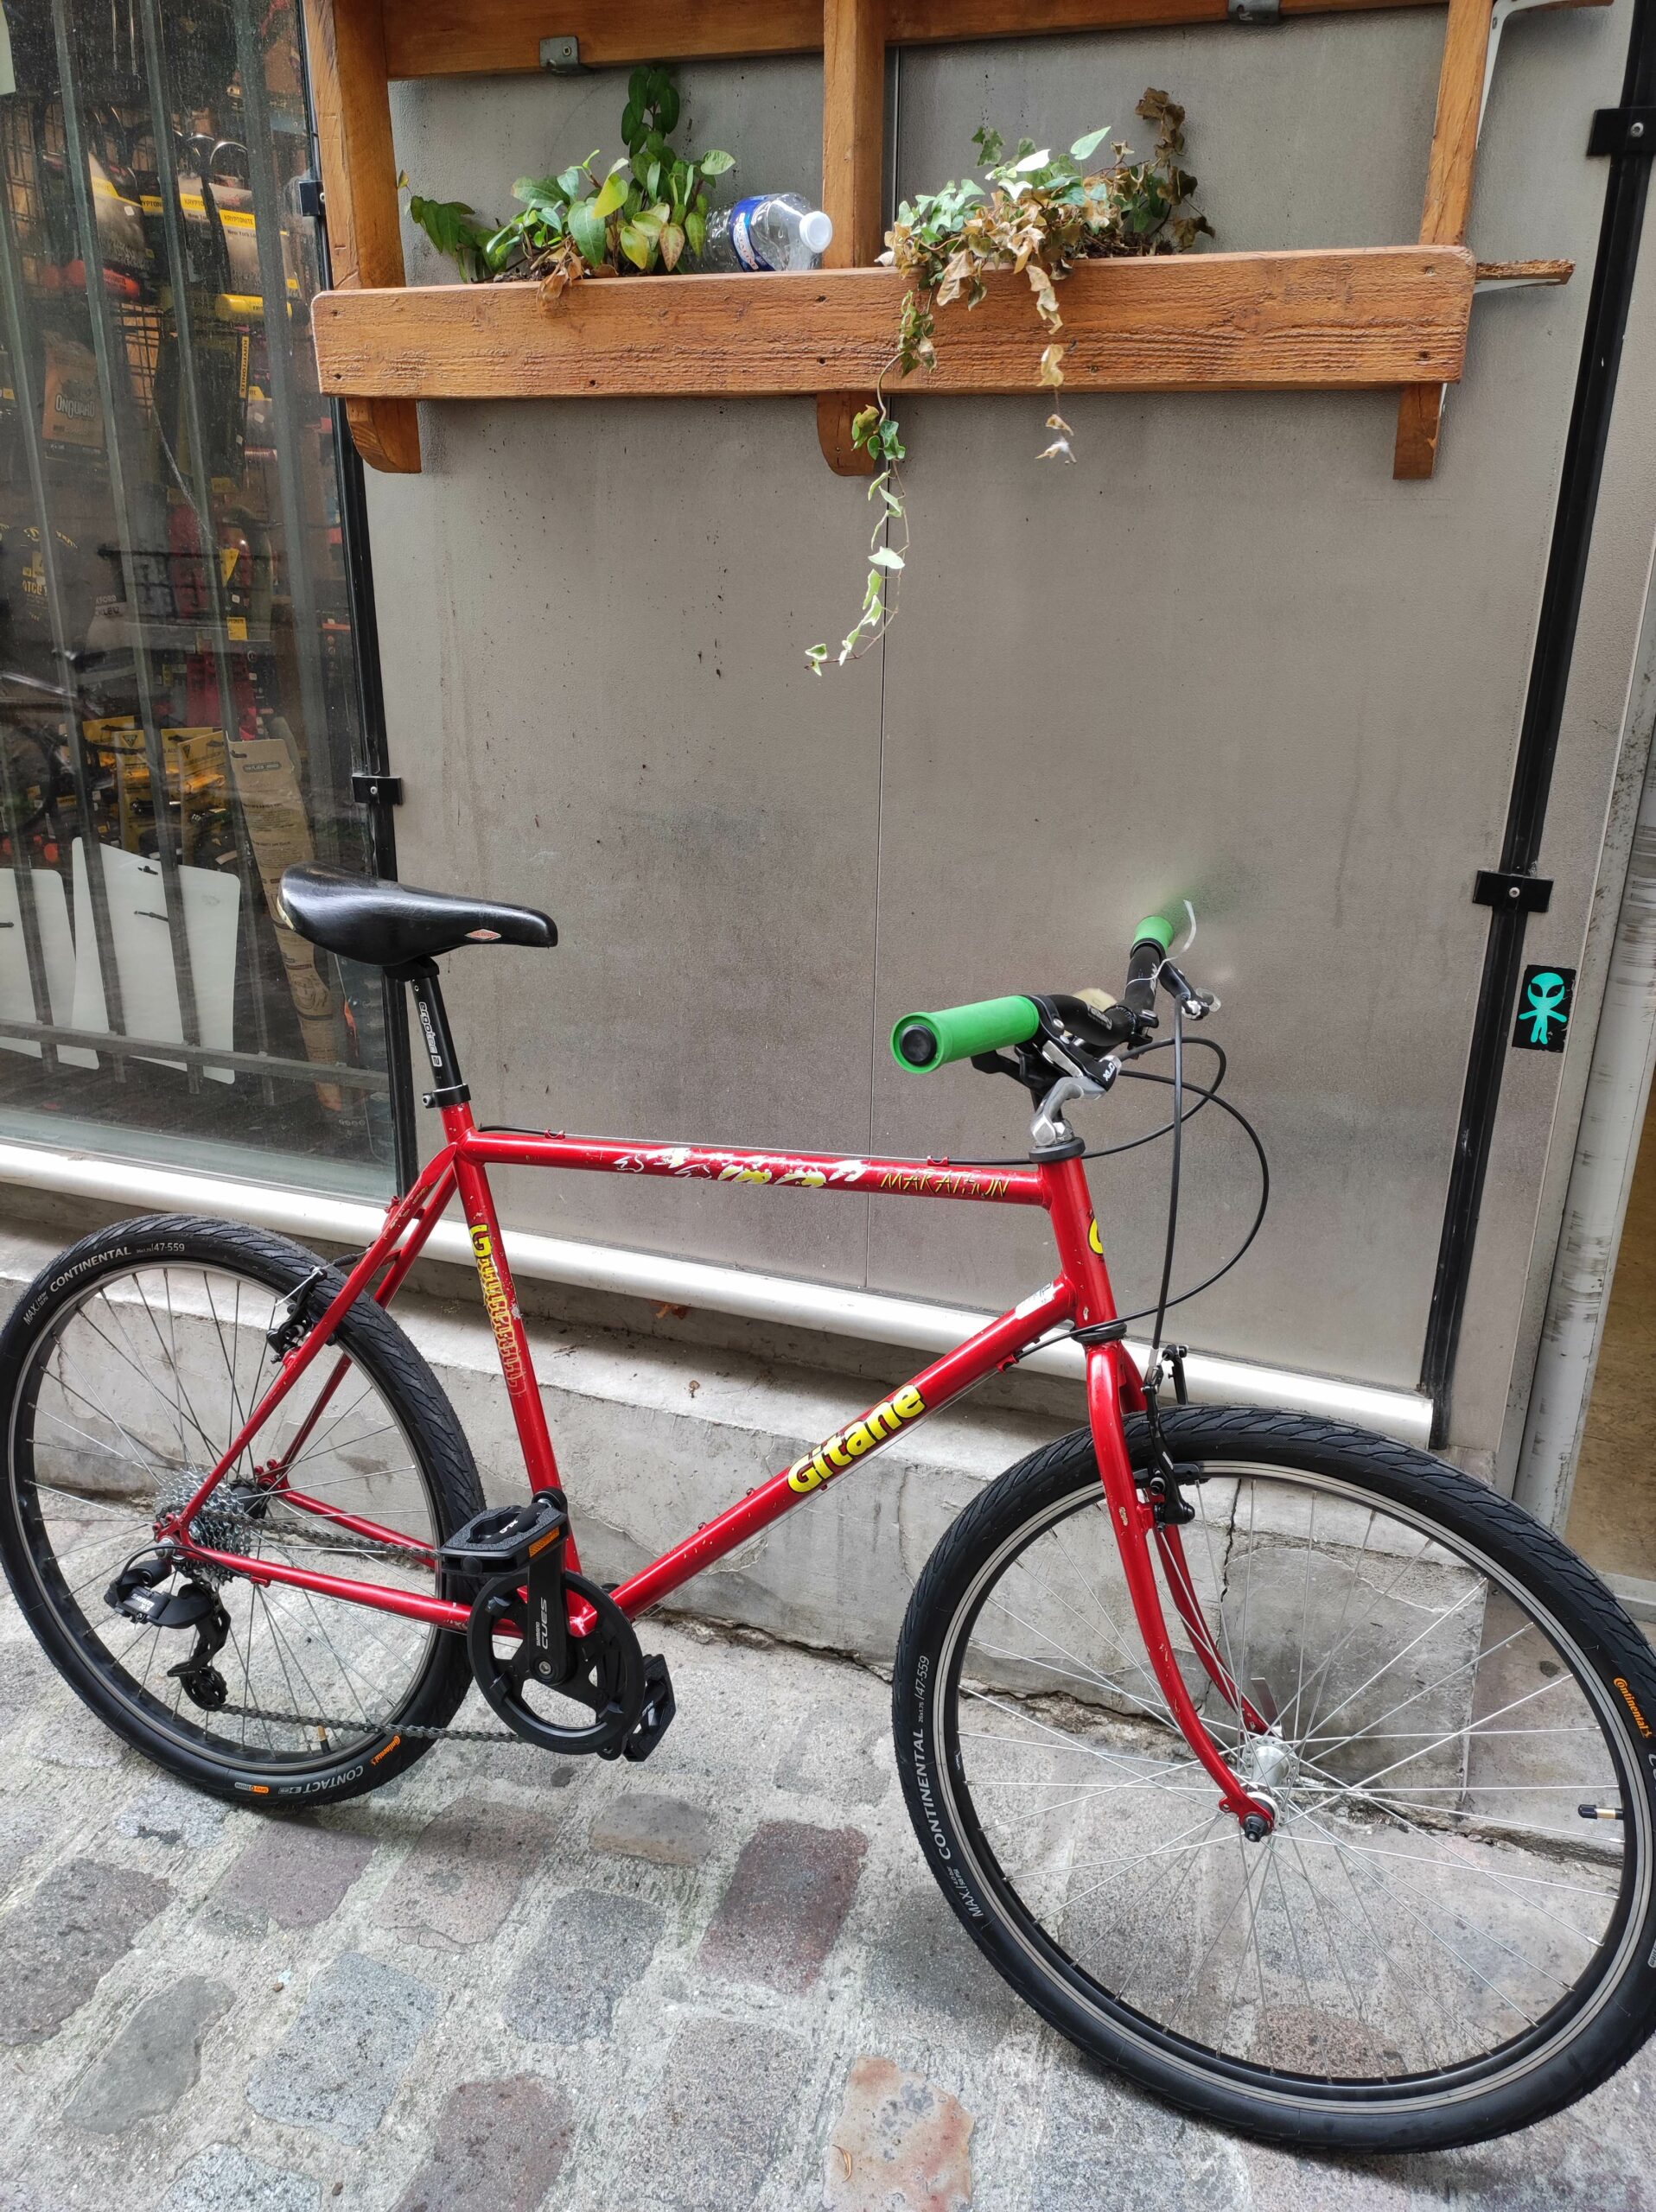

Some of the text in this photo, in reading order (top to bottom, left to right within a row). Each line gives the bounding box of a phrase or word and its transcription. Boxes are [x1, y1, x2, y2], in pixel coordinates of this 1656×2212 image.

[49, 1246, 132, 1294] CONTINENTAL
[787, 1384, 927, 1493] Gitane
[540, 1598, 549, 1650] CUES
[1613, 1677, 1648, 1732] Continental
[373, 1735, 401, 1764] Continental
[303, 1765, 364, 1795] CONTACT
[913, 1728, 952, 1860] CONTINENTAL
